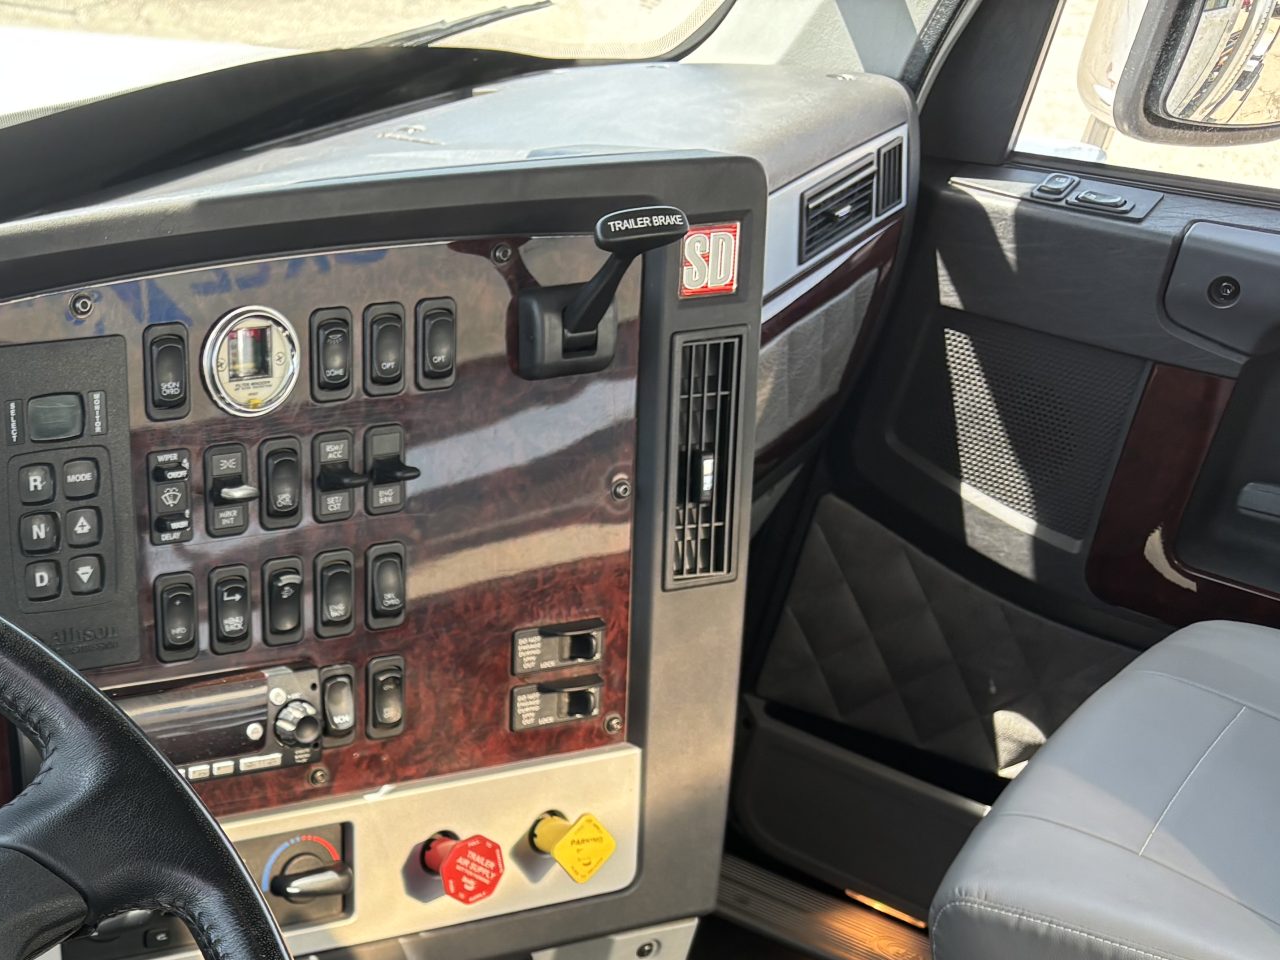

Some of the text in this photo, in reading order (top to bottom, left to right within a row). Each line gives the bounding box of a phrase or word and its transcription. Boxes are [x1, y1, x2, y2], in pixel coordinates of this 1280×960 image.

[608, 214, 684, 232] TRAILER BRAKE
[683, 232, 734, 290] SD
[381, 362, 395, 370] OPT
[432, 355, 446, 363] OPT
[326, 367, 344, 377] DOME
[93, 393, 102, 433] MONITOR
[10, 402, 18, 442] SELECT
[157, 453, 178, 462] WIPER
[29, 475, 43, 491] R
[67, 472, 93, 483] MODE
[32, 524, 46, 540] N
[161, 532, 181, 541] DELAY
[35, 572, 49, 588] D
[456, 856, 470, 867] AIR
[469, 862, 496, 880] SUPPLY
[467, 850, 496, 870] TRAILER
